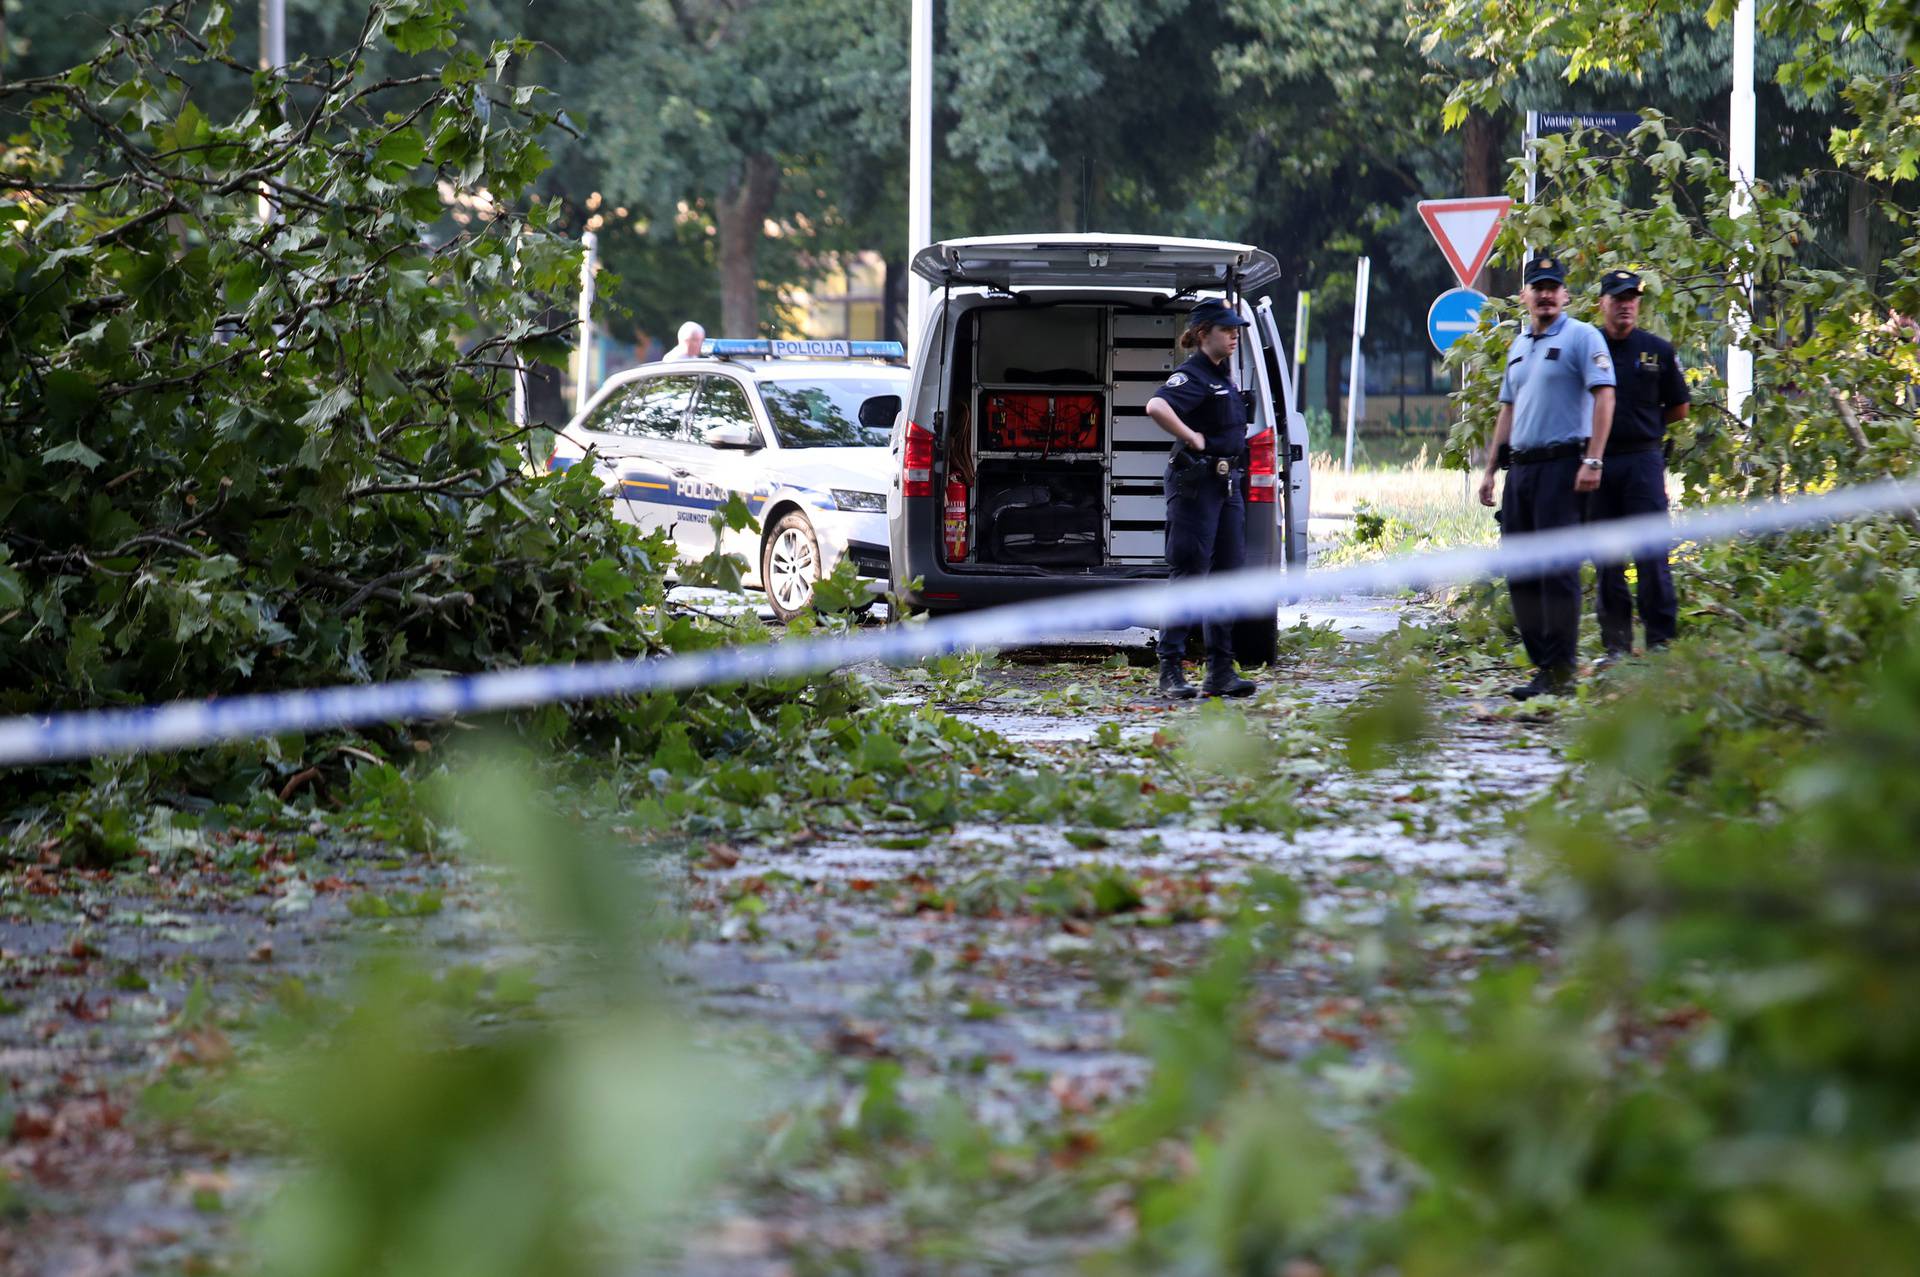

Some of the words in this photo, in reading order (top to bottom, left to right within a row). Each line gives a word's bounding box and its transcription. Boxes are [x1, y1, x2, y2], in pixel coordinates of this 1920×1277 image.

[1543, 114, 1595, 128] Vatikaka
[777, 342, 845, 355] POLICIJA
[677, 511, 708, 523] SIGURNOST
